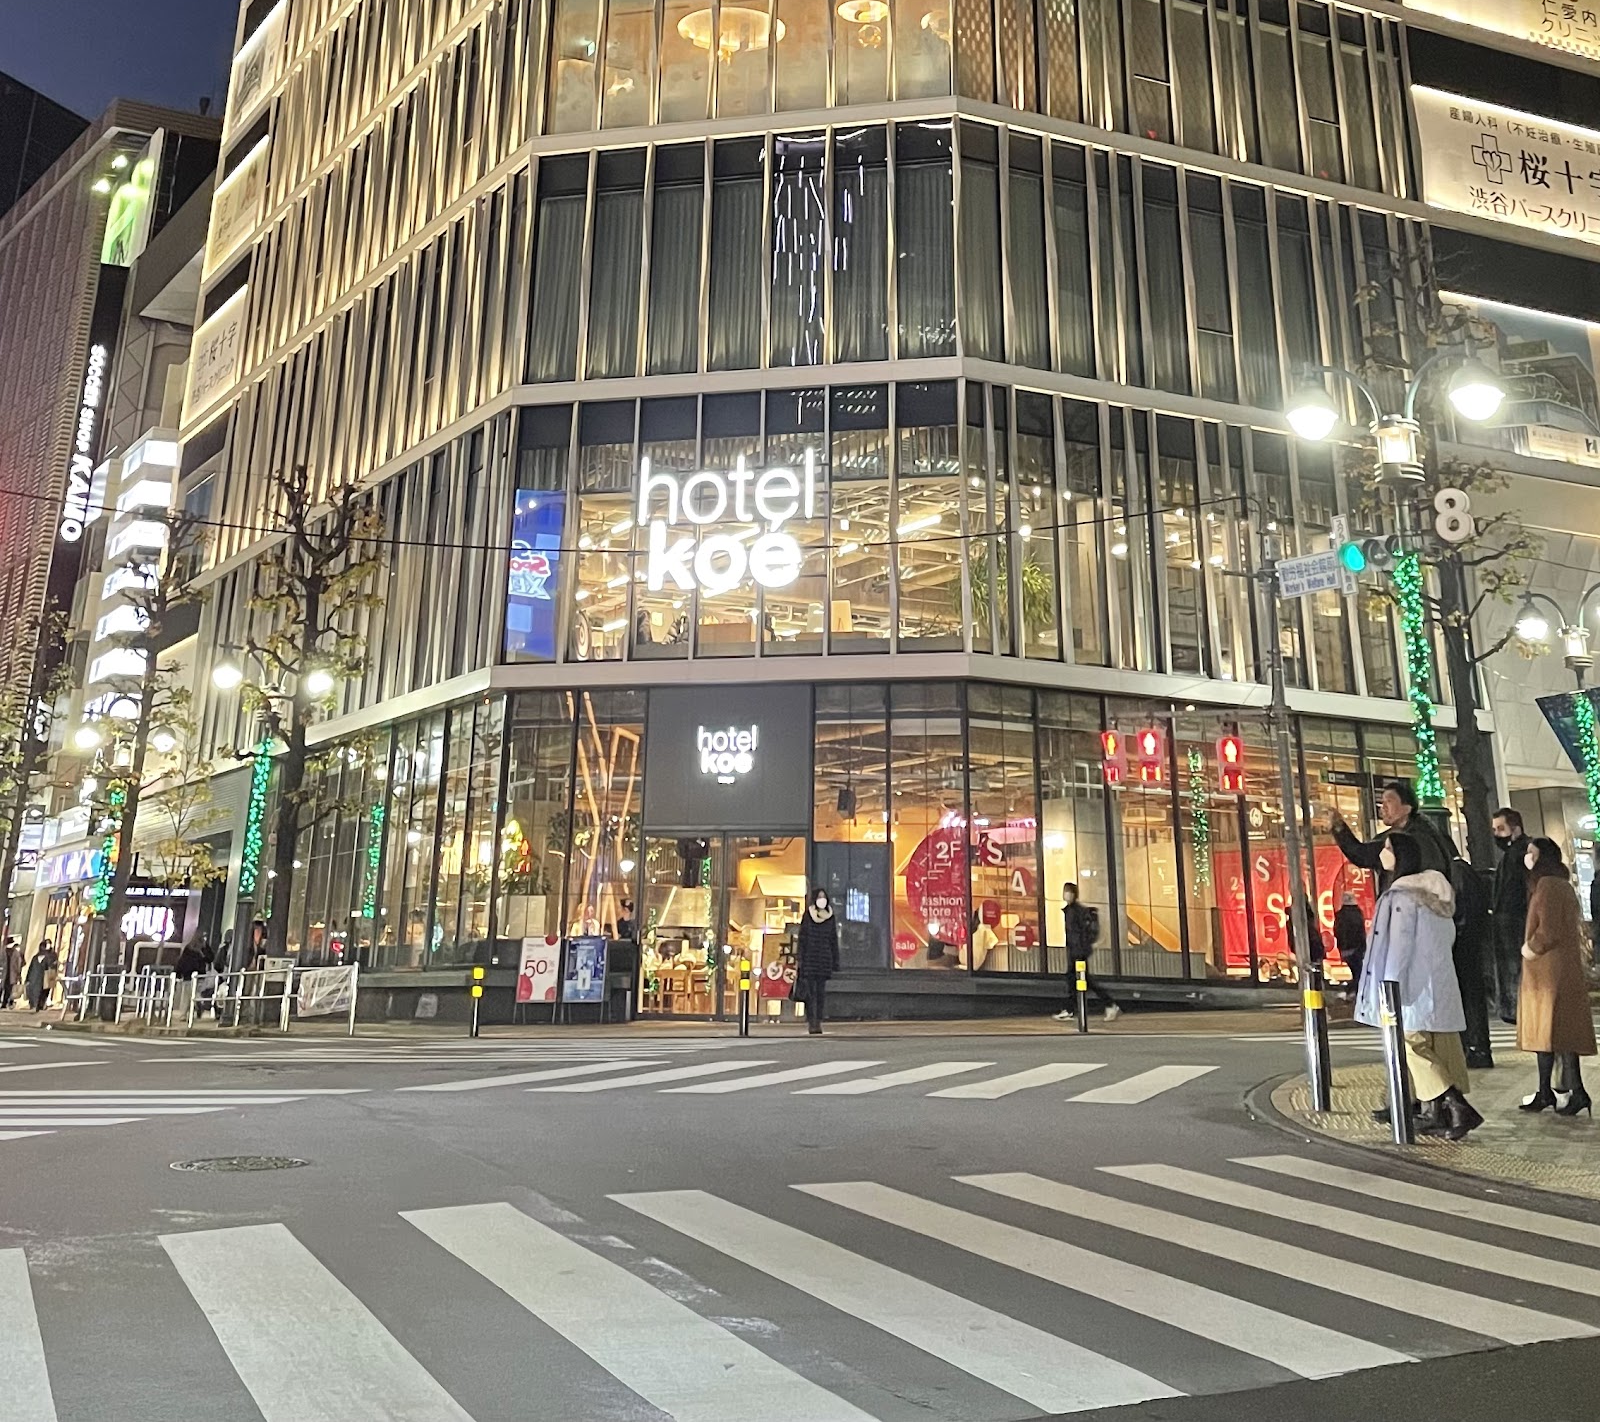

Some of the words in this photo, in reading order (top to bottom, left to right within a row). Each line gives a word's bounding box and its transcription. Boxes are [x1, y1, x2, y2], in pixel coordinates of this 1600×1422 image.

[83, 344, 105, 407] SOCCER
[76, 407, 95, 452] SHOP
[637, 447, 814, 526] hotel
[1434, 488, 1475, 542] 8
[647, 521, 802, 598] koe
[697, 724, 758, 752] hotel
[701, 747, 753, 774] koe
[936, 841, 961, 859] 2F
[1352, 868, 1371, 884] 2F
[922, 896, 963, 906] fashion
[922, 906, 951, 917] store
[895, 940, 916, 952] sale
